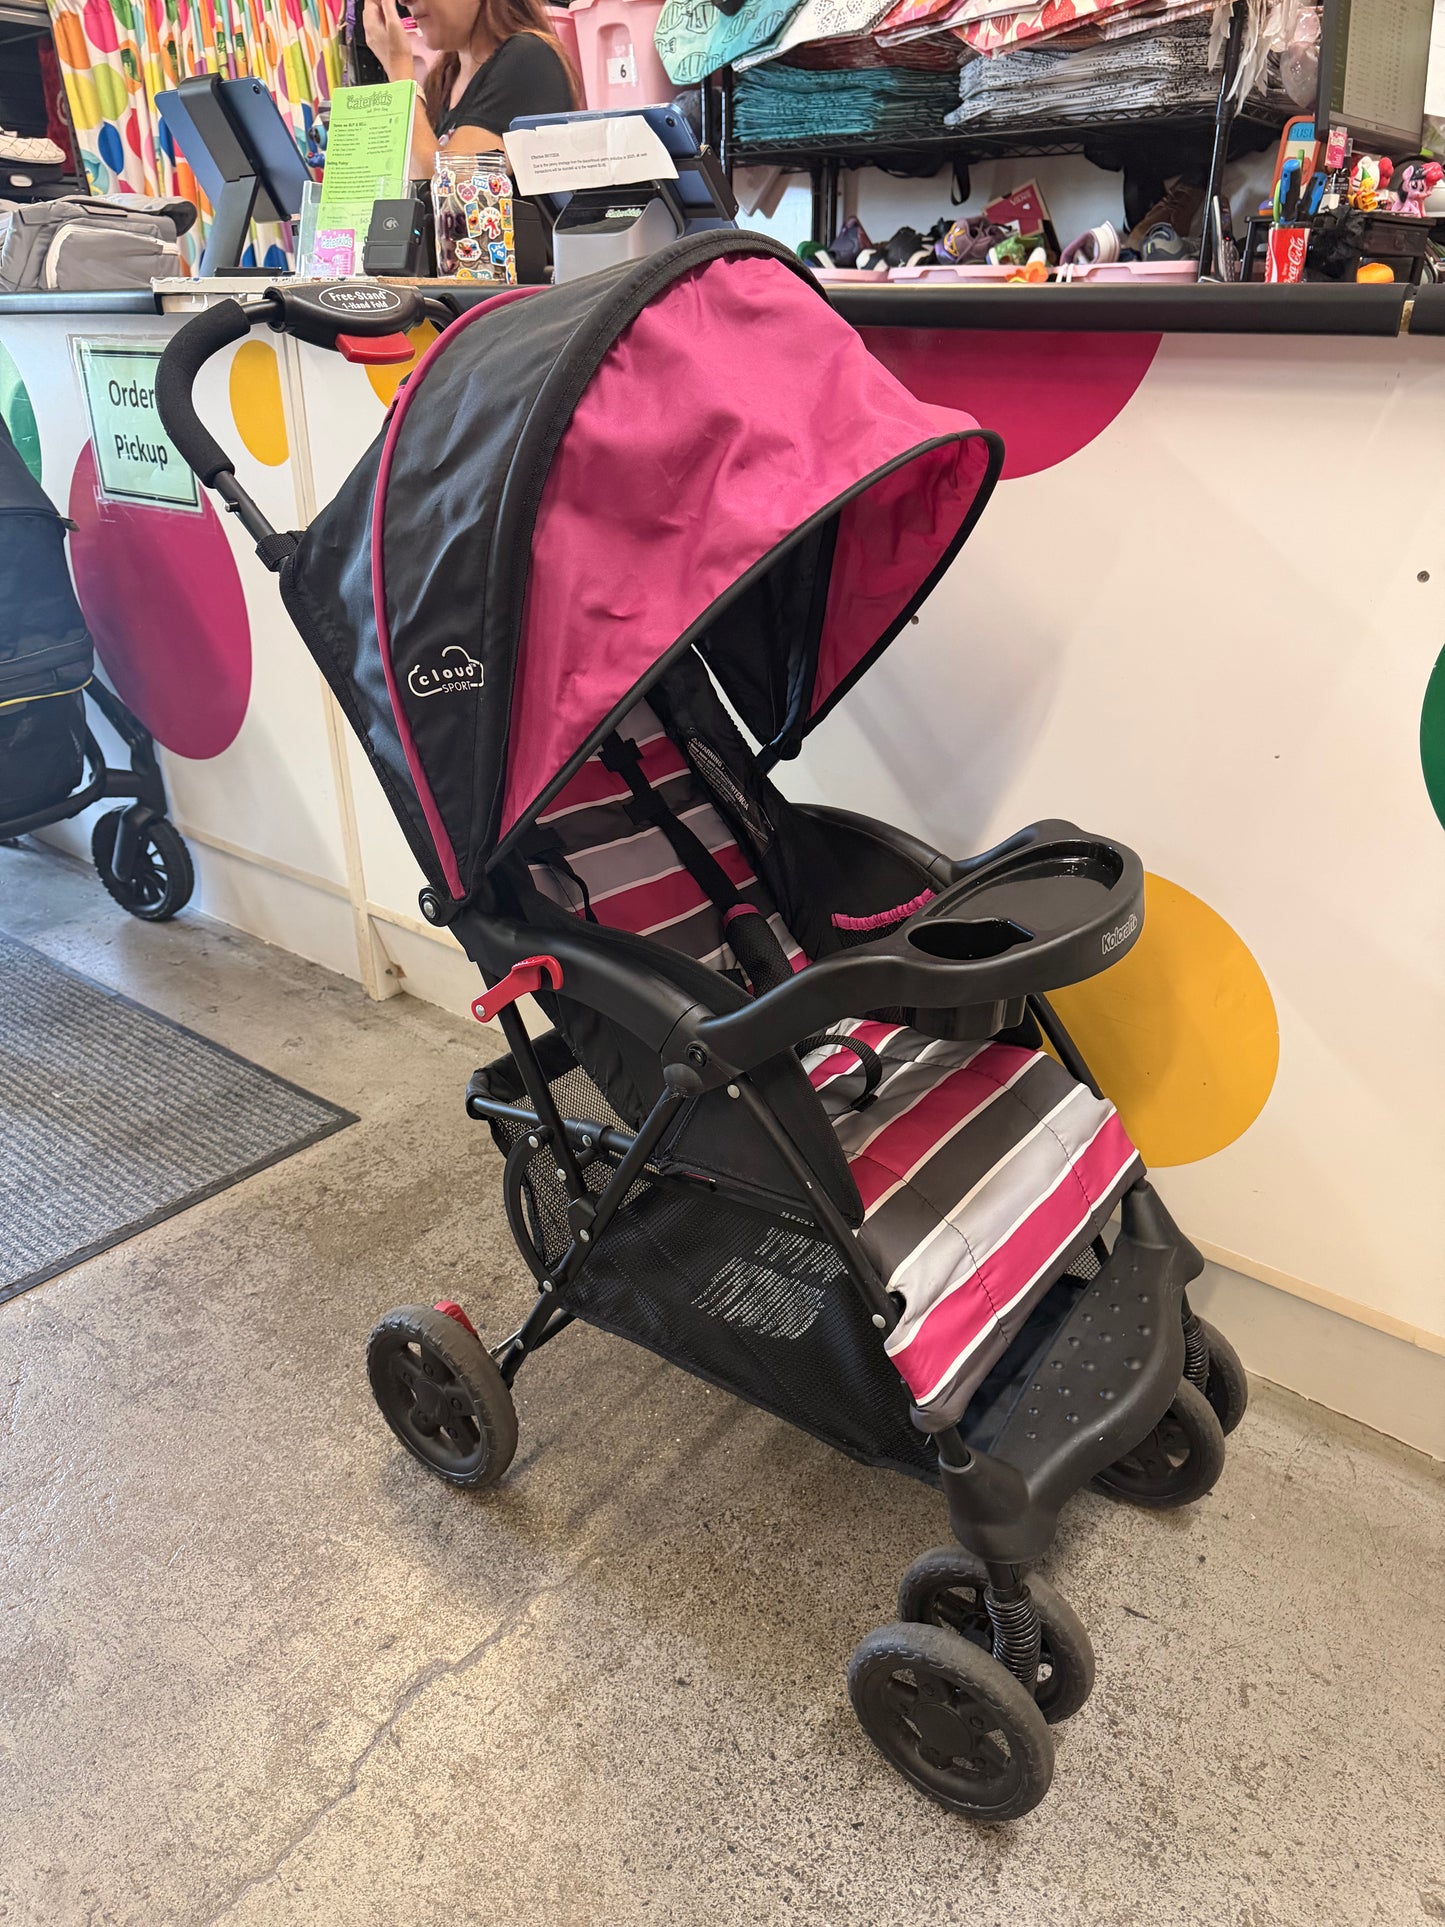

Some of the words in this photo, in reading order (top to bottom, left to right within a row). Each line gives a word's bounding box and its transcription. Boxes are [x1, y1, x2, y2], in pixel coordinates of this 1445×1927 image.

[620, 64, 627, 78] 6
[1283, 236, 1305, 283] oca-Cola
[328, 290, 386, 302] Free-Stand
[342, 300, 371, 310] 1-Hand
[371, 300, 388, 309] Fold
[108, 380, 155, 409] Order
[114, 434, 169, 471] Pickup
[419, 663, 475, 686] cloud
[441, 681, 472, 694] SPORT
